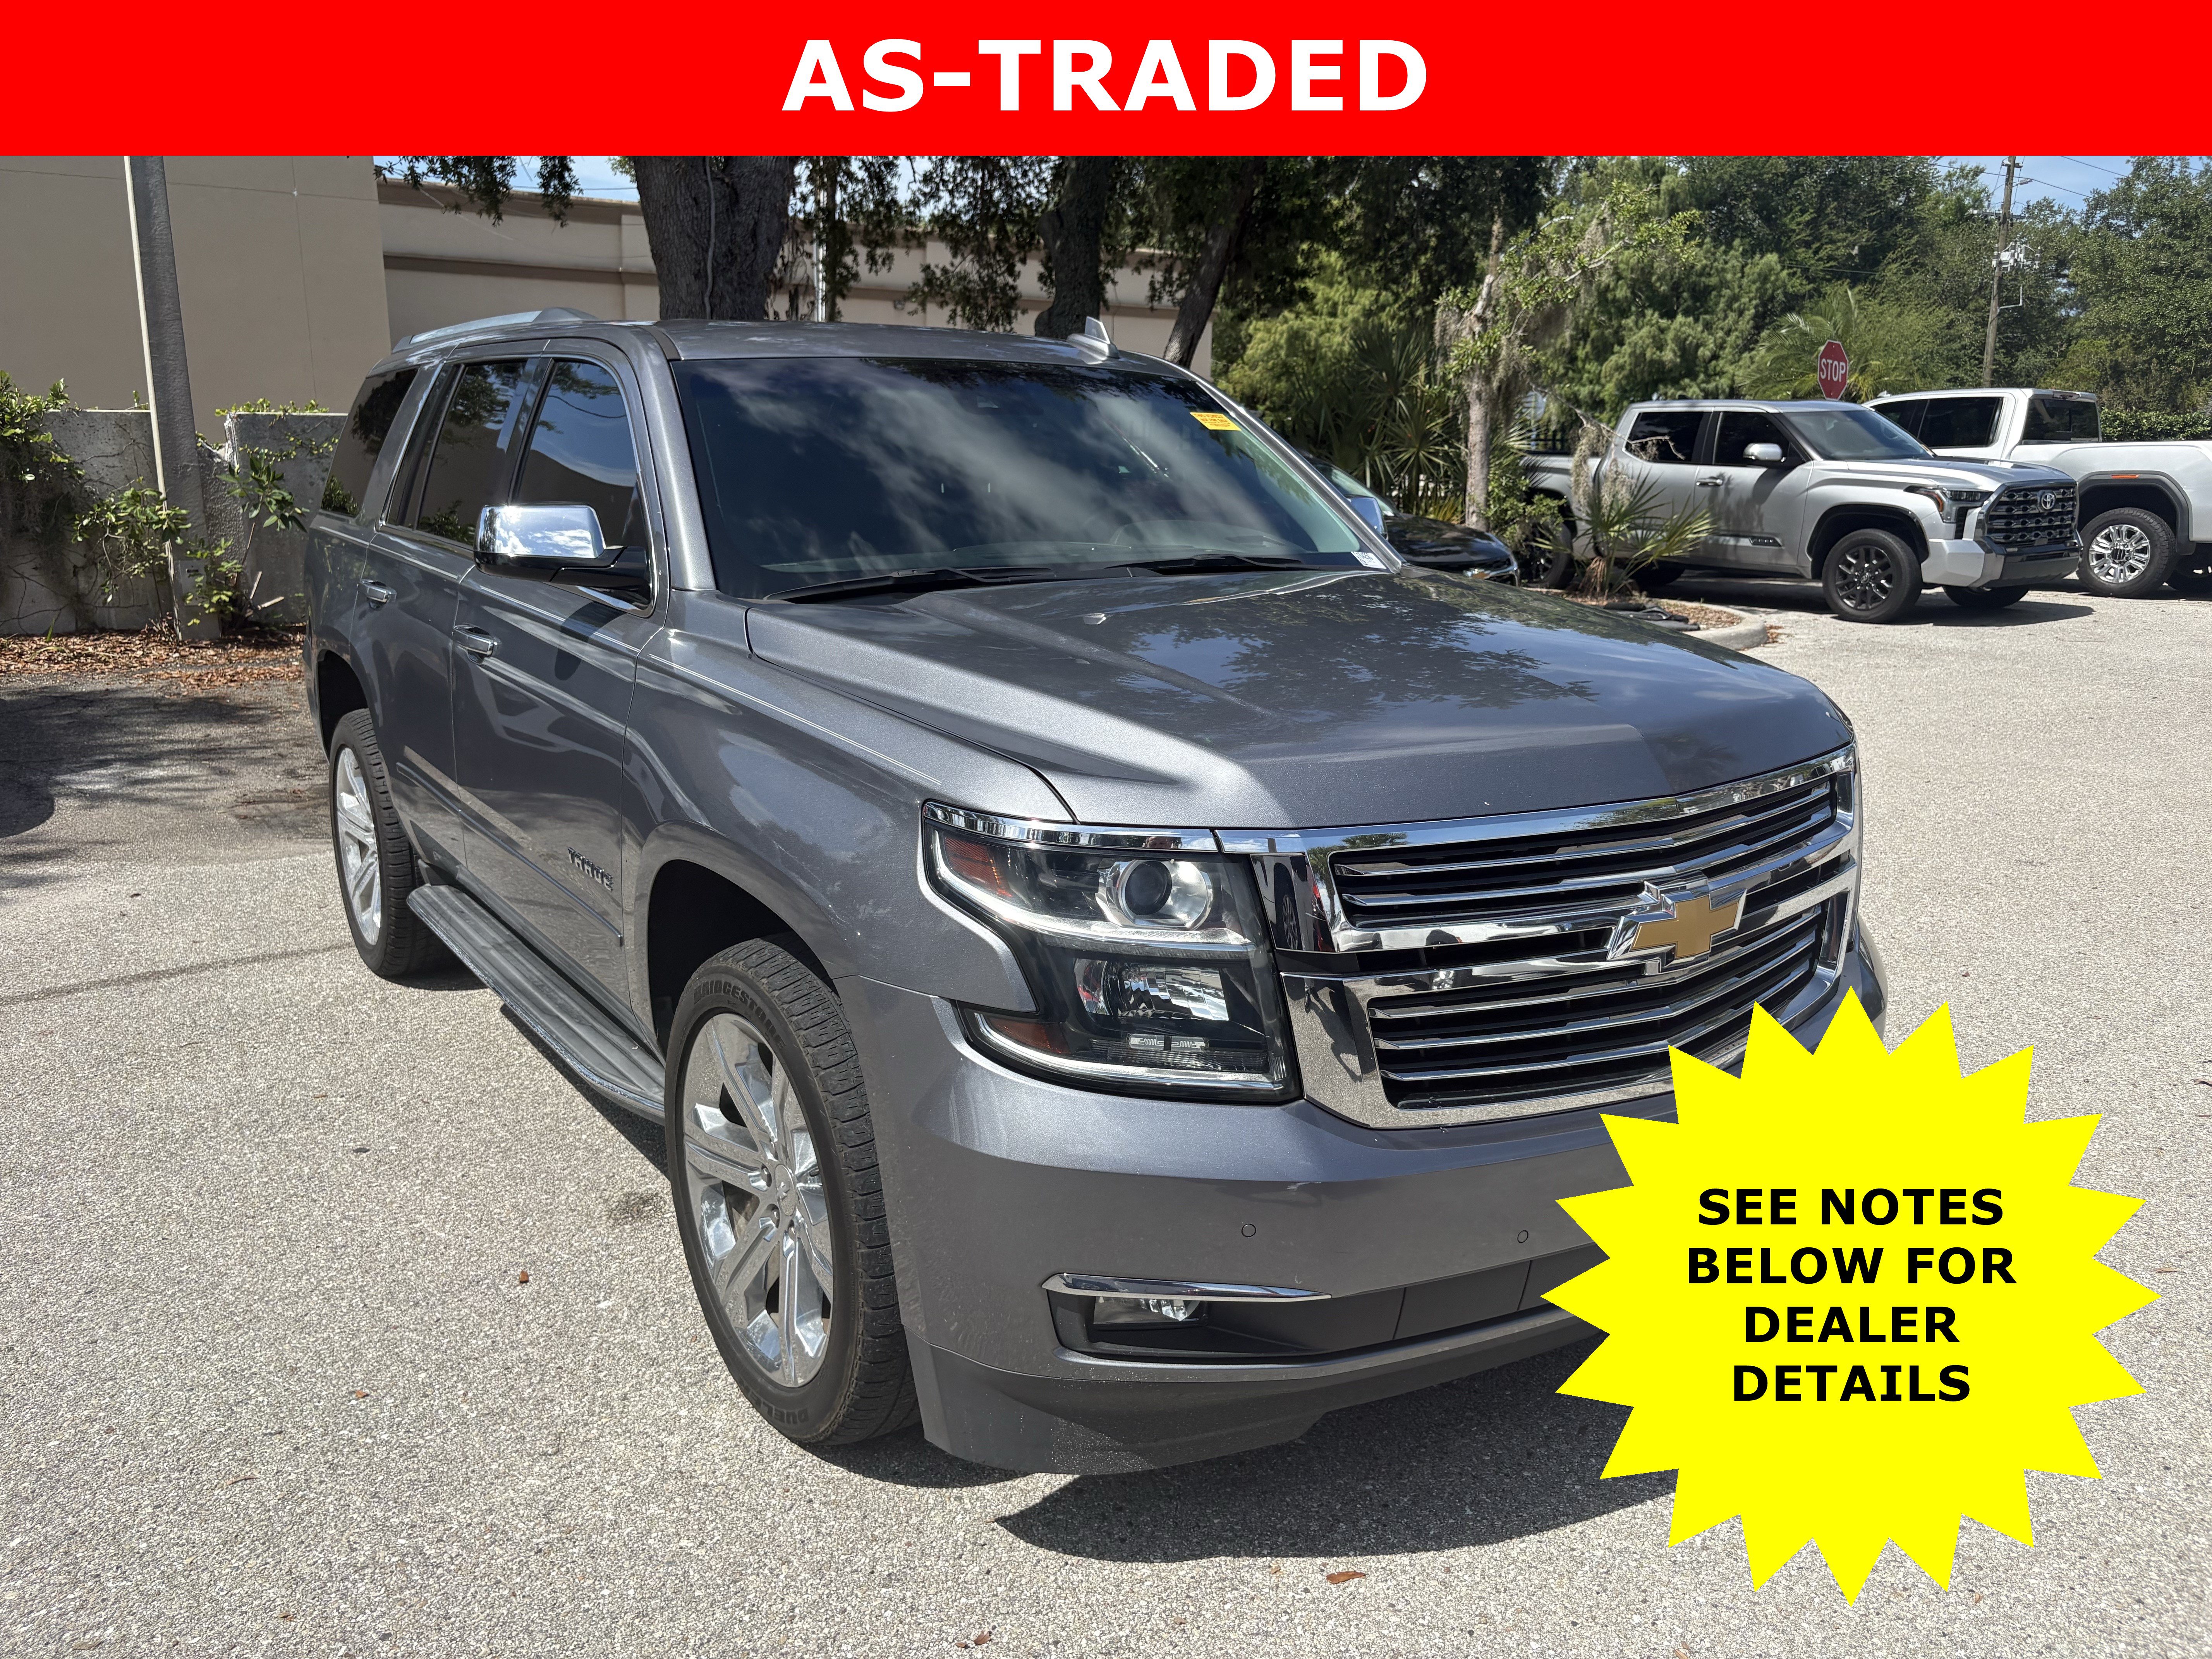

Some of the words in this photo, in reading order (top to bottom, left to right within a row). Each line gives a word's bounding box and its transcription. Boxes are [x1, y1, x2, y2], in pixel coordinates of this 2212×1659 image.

[1820, 358, 1846, 382] STOP
[568, 847, 613, 891] TAHOE
[694, 980, 787, 1050] BRIDGESTONE
